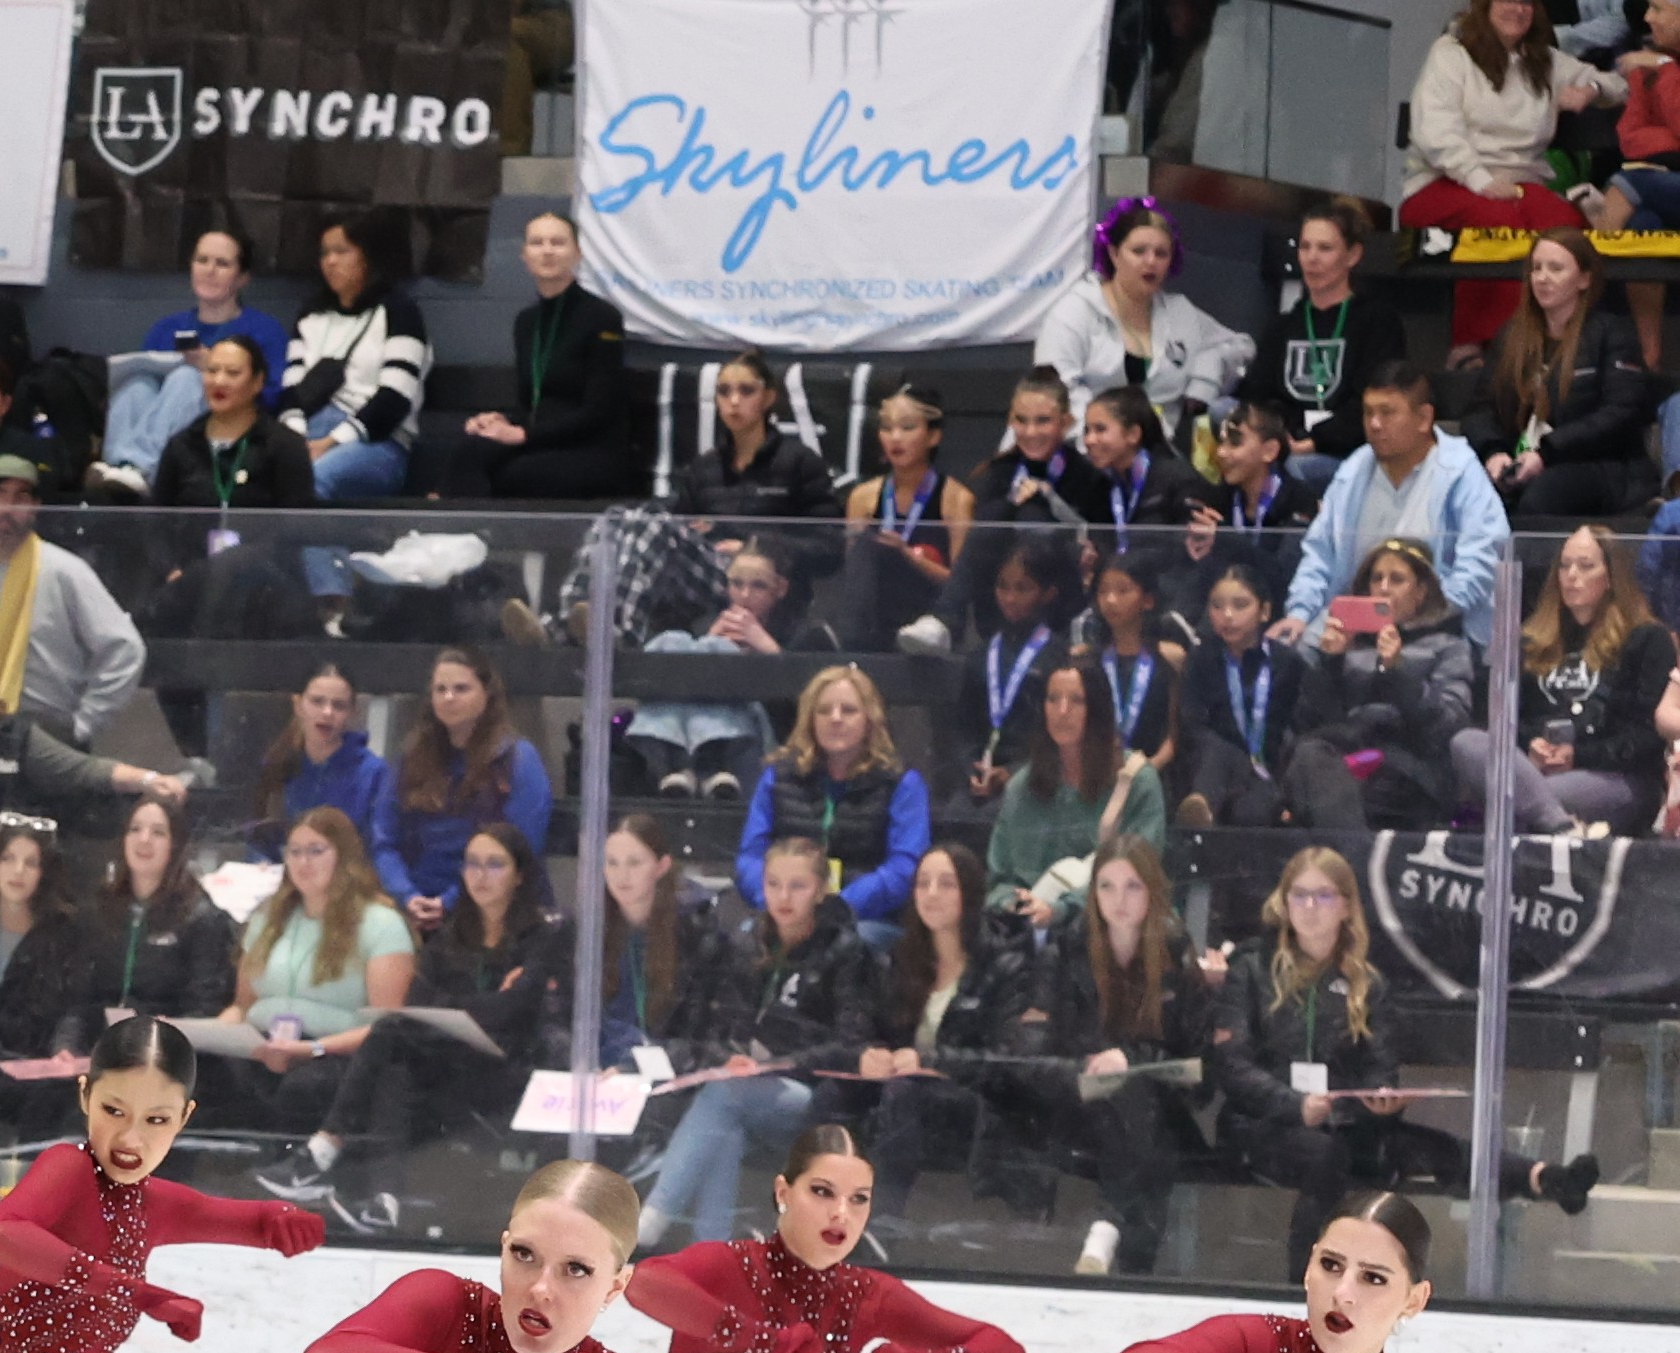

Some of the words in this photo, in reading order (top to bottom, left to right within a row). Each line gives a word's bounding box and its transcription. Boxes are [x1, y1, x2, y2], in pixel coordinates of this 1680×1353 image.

[102, 85, 169, 141] LA
[192, 86, 492, 147] SYNCHRO
[590, 88, 1078, 273] Skyliners
[721, 278, 897, 301] SYNCHRONIZED
